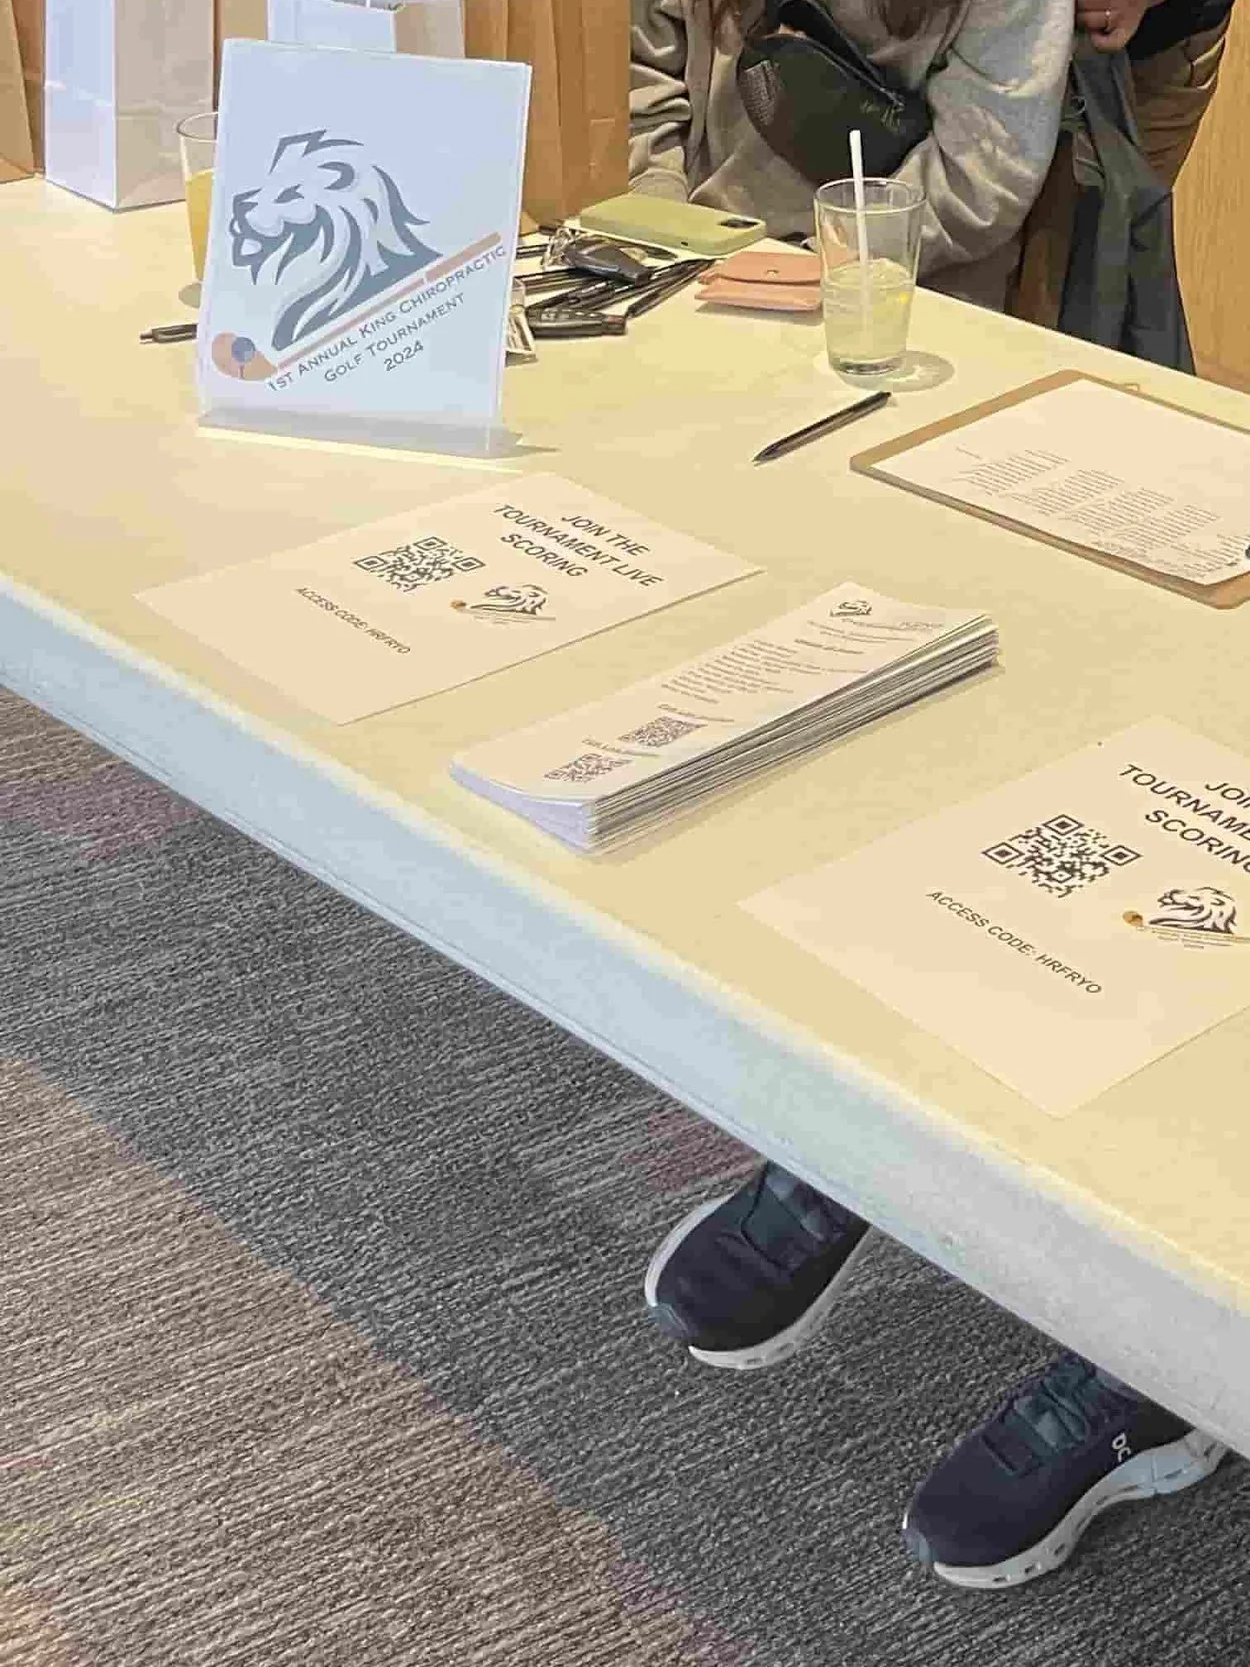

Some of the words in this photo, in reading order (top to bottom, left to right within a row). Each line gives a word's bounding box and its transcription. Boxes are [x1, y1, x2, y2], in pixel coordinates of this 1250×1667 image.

[268, 371, 294, 393] 1ST
[298, 338, 358, 376] ANNUAL
[359, 311, 397, 341] KING
[399, 245, 507, 315] CHIROPRACTIC
[324, 354, 363, 384] GOLF
[366, 293, 467, 358] TOURNAMENT
[384, 341, 425, 373] 2024
[493, 504, 618, 568] TOURNAMENT
[613, 562, 665, 589] LIVE
[500, 533, 588, 580] SCORING
[561, 514, 609, 539] JOIN
[612, 532, 651, 557] THE
[925, 890, 991, 928] ACCESS
[987, 924, 1038, 958] CODE:
[1034, 950, 1103, 995] HRFRYO
